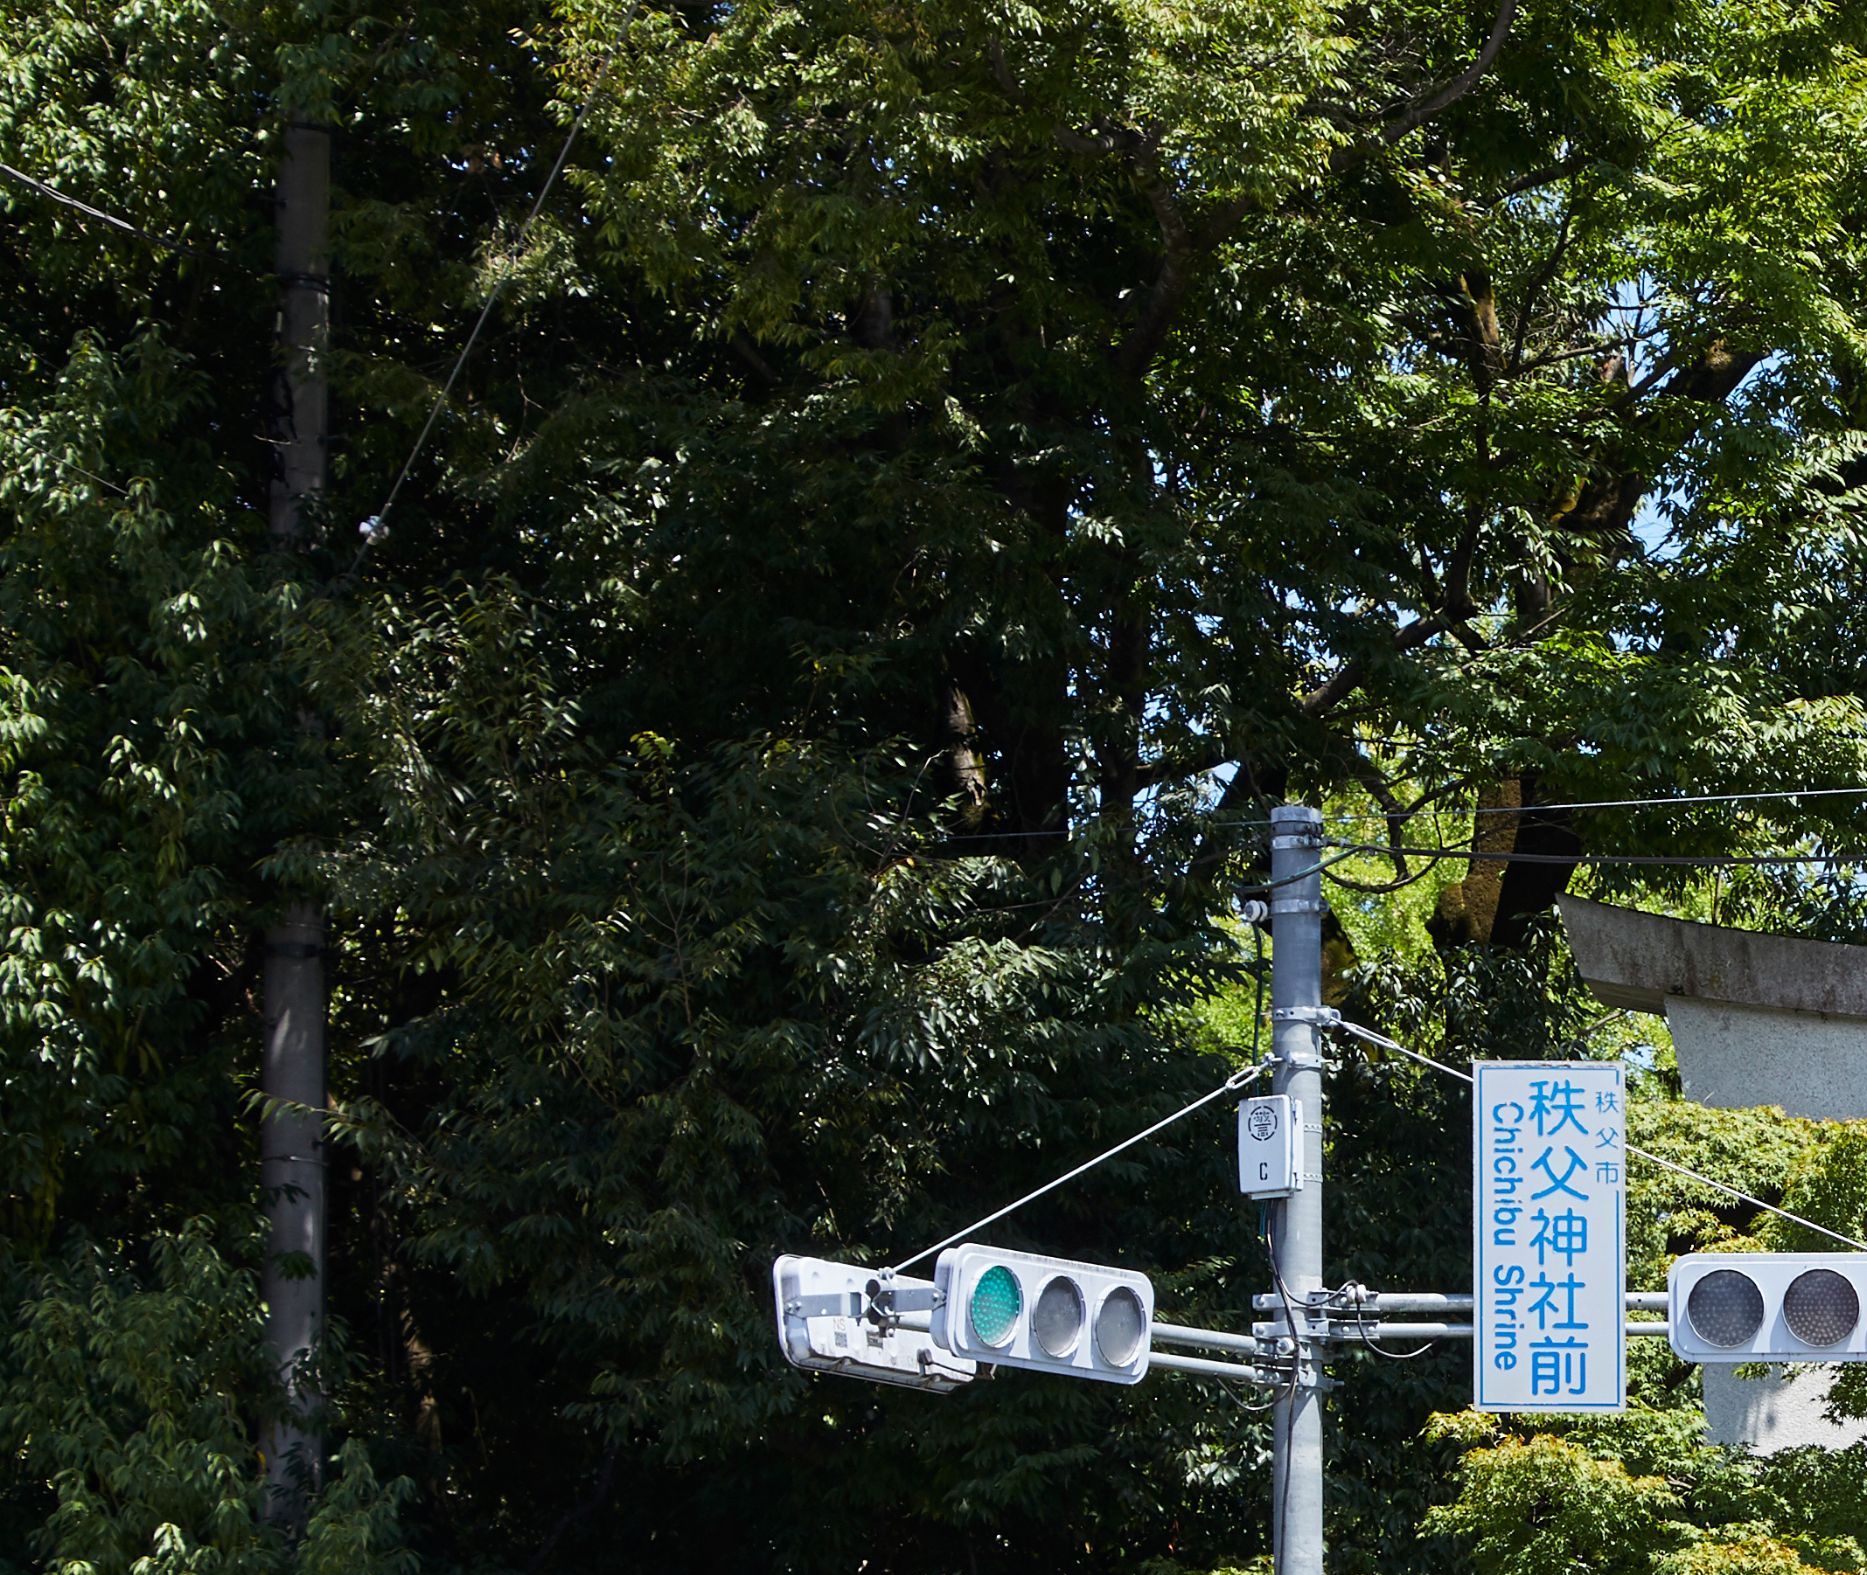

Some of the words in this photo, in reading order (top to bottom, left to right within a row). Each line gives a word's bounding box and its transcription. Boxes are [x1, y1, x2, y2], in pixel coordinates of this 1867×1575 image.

[1259, 1162, 1268, 1181] C
[1492, 1102, 1524, 1246] Chichibu
[1595, 1090, 1619, 1184] 秩父市
[1528, 1079, 1589, 1396] 秩父神社前
[1493, 1264, 1525, 1371] Shrine
